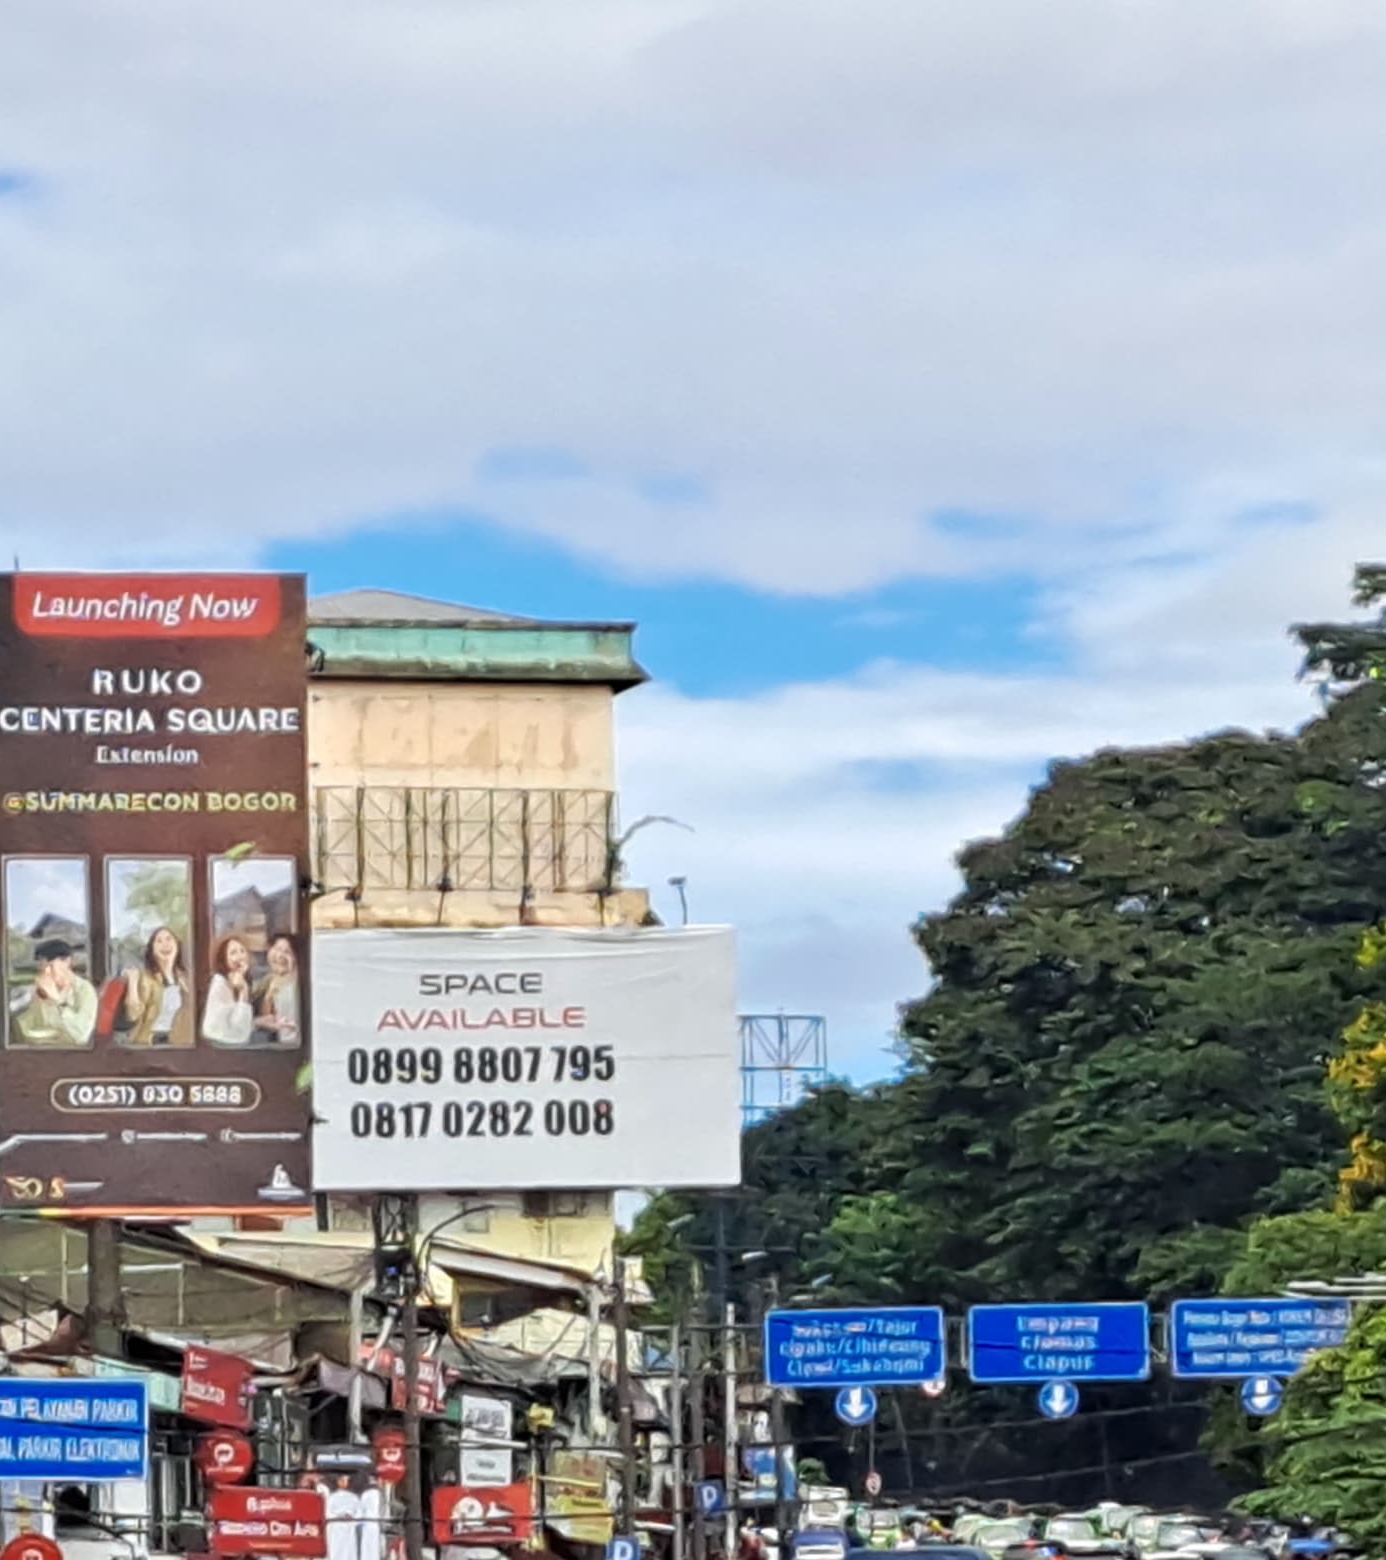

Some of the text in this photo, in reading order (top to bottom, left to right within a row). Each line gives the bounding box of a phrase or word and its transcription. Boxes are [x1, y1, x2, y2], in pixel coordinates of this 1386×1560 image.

[32, 591, 259, 627] Launching Now
[92, 669, 203, 695] RUKO
[166, 707, 300, 733] SQUARE
[95, 744, 199, 764] Extension
[206, 792, 297, 812] BOGOR
[418, 972, 543, 995] SPACE
[377, 1006, 586, 1032] AVAILABLE
[347, 1044, 615, 1085] 0899 8807 795
[68, 1084, 136, 1107] (0251)
[350, 1099, 615, 1139] 0817 0282 008
[92, 1399, 139, 1423] PARKIR
